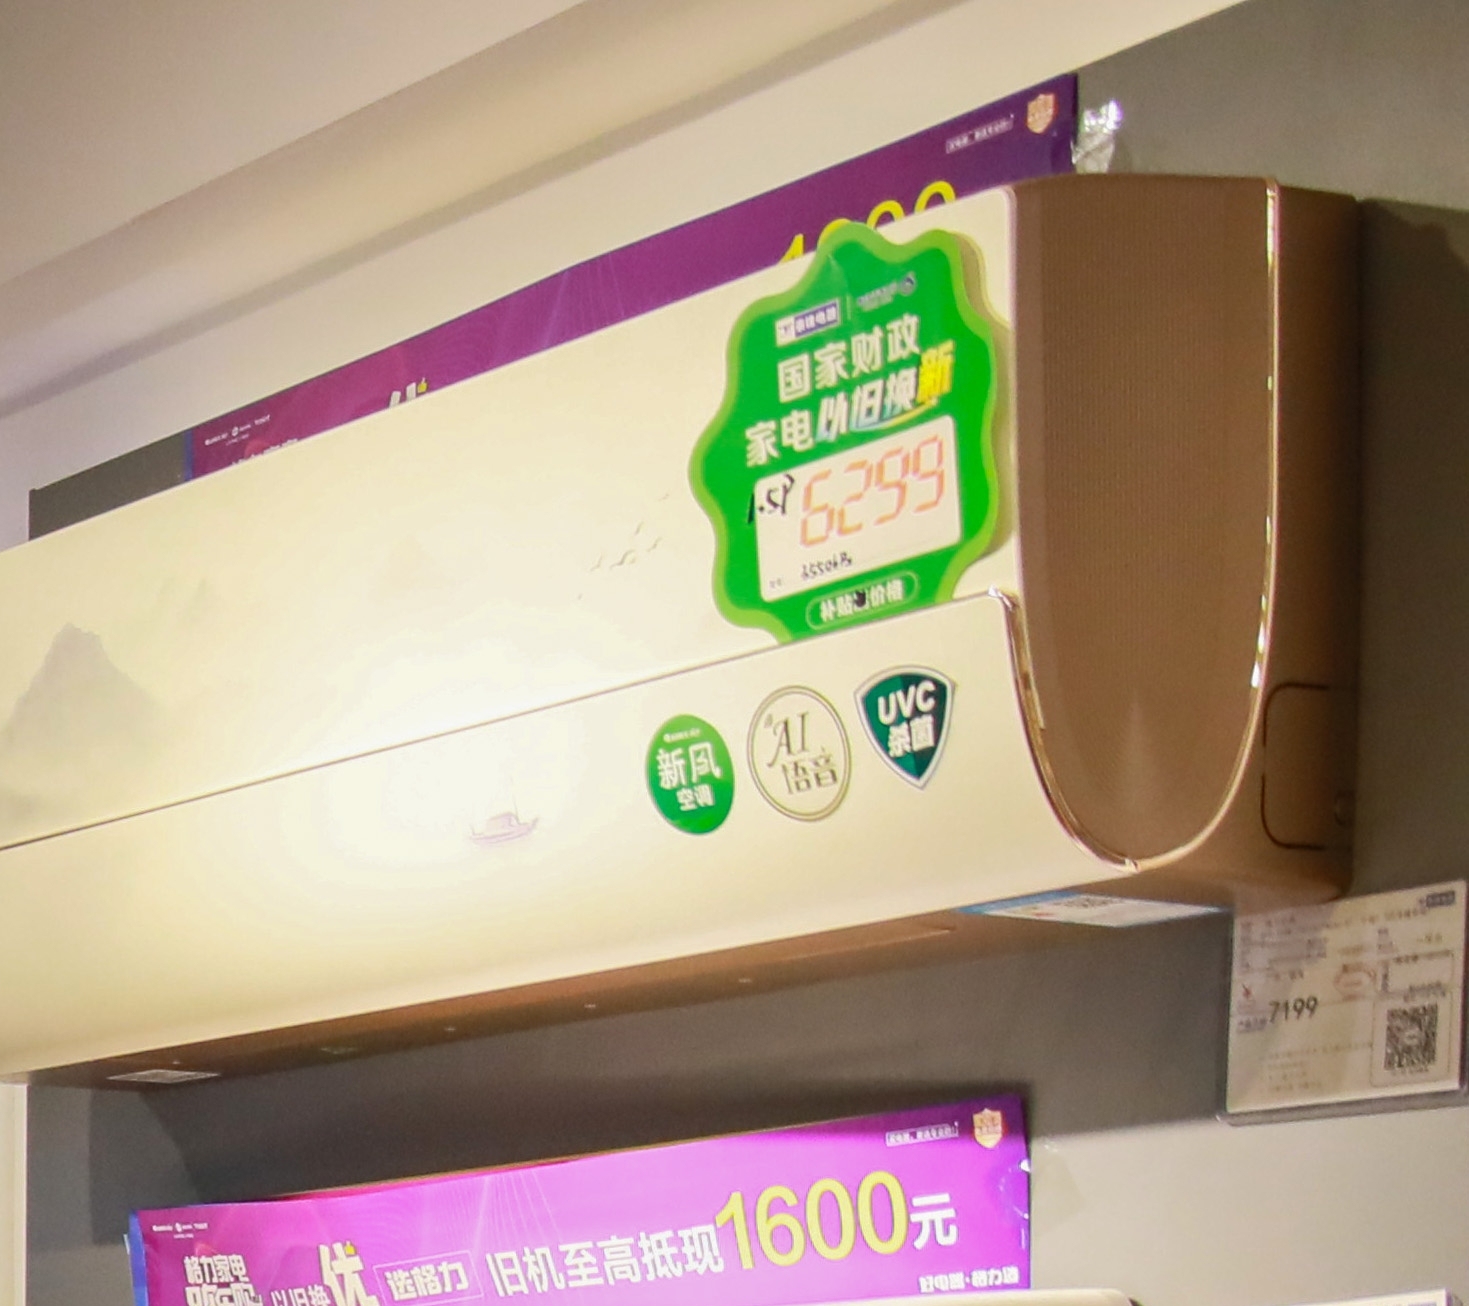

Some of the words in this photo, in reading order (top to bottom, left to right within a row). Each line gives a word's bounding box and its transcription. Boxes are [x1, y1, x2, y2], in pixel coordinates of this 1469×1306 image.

[778, 314, 920, 402] 国家财政
[746, 341, 954, 467] 家电以旧换新
[801, 434, 944, 547] 6299
[878, 681, 935, 725] UVC
[887, 715, 935, 757] 杀菌
[656, 742, 721, 789] 新风
[782, 745, 837, 794] 语音
[677, 785, 715, 811] 空调
[1269, 997, 1318, 1024] 7199
[385, 1262, 470, 1302] 选格力
[486, 1170, 960, 1297] 旧机至高抵现1600元
[184, 1254, 249, 1284] 格力家电
